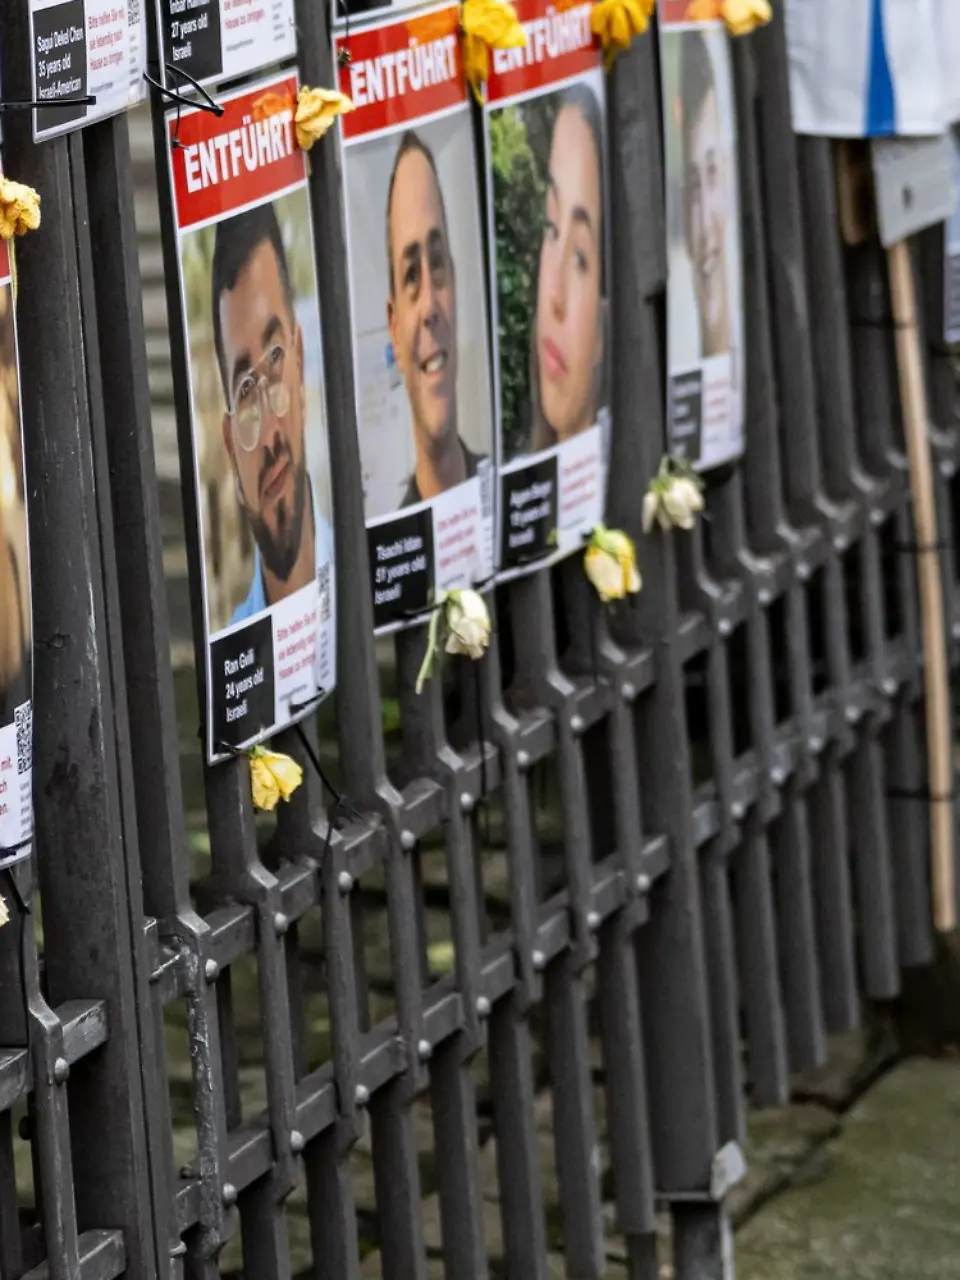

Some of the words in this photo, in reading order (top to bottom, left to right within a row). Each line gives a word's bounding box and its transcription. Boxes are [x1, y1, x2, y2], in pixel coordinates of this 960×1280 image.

[172, 21, 180, 37] 27
[180, 20, 199, 38] years
[198, 13, 209, 29] old
[173, 42, 192, 60] Israeli
[351, 34, 457, 109] ENTFÜHRT
[184, 110, 294, 194] ENTFÜHRT
[225, 658, 240, 676] Ran
[226, 682, 236, 699] 24
[235, 675, 255, 698] years
[255, 667, 264, 685] old
[227, 700, 248, 722] Israeli
